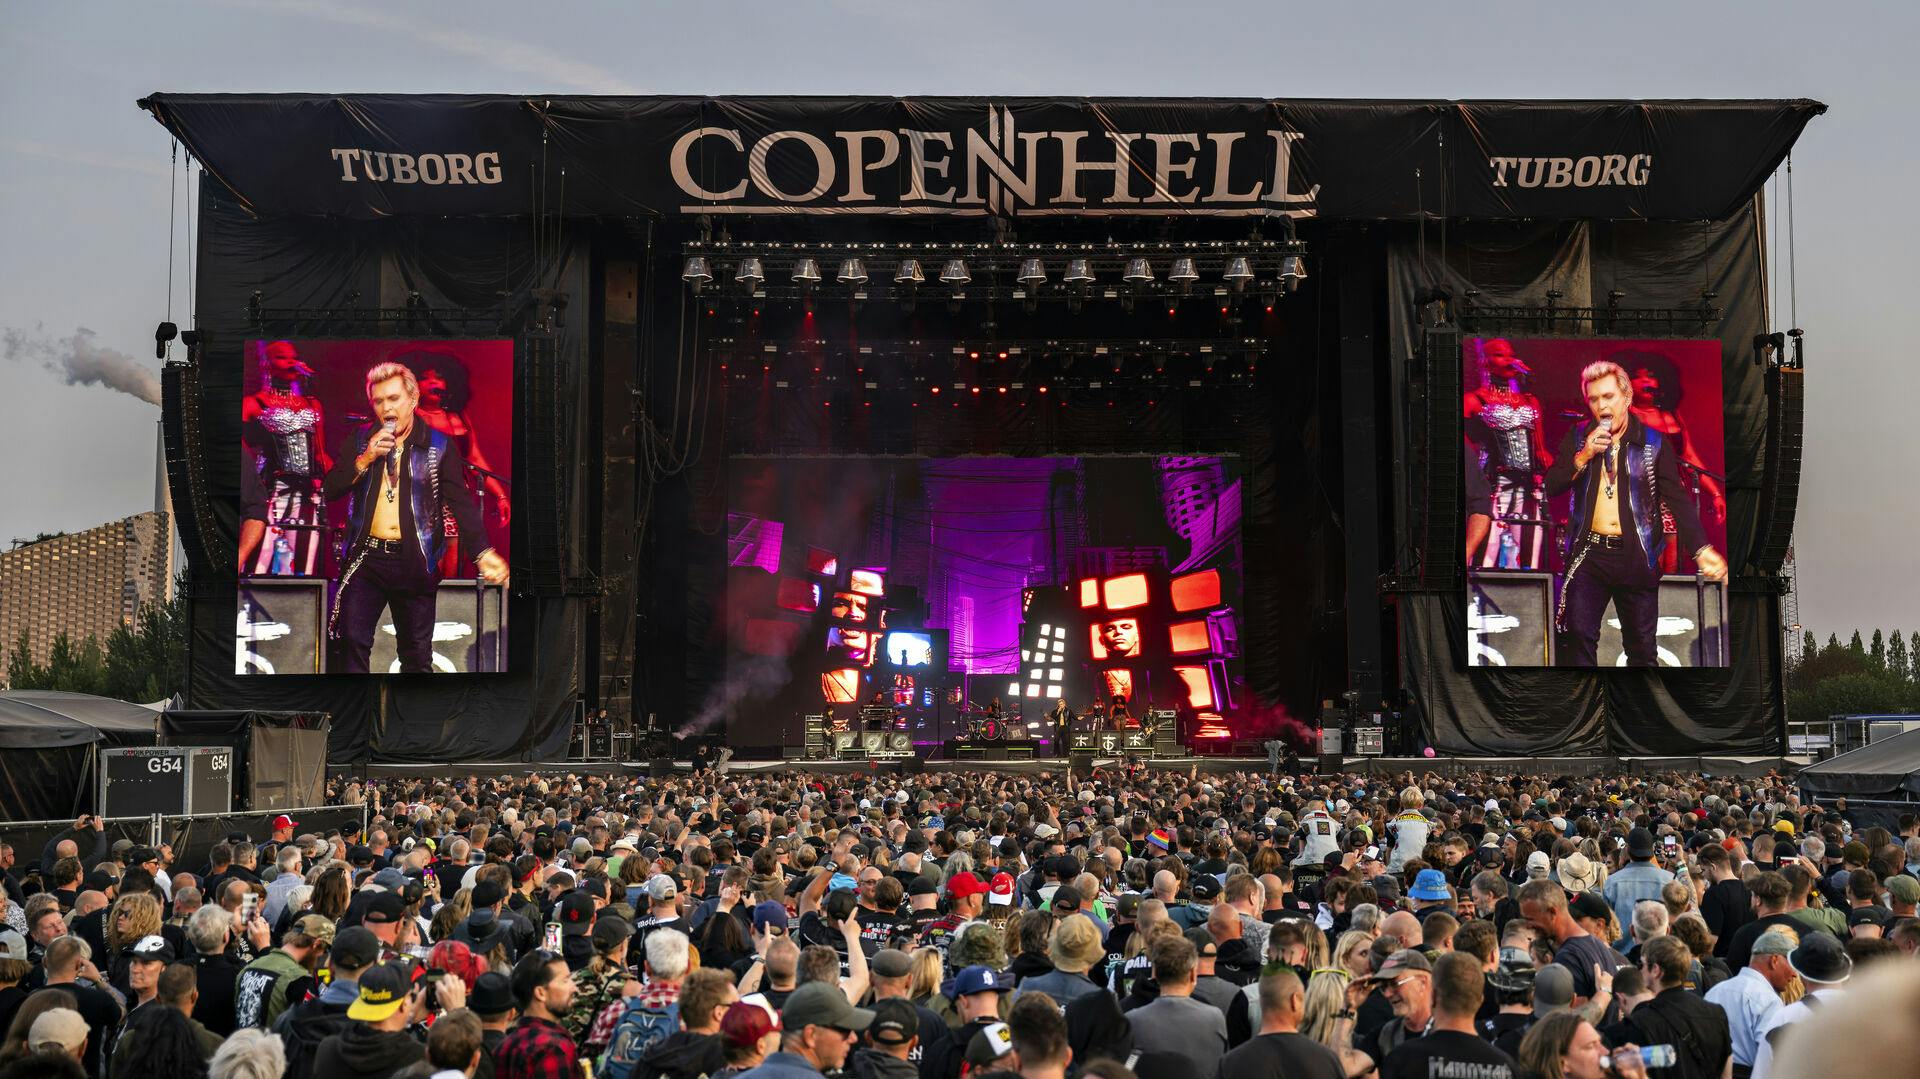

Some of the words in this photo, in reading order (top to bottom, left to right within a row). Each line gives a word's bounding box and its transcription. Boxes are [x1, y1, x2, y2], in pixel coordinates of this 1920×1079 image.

[331, 148, 503, 185] TUBORG
[669, 102, 1321, 217] COPENHELL
[1489, 153, 1652, 188] TUBORG
[147, 757, 183, 773] G54
[211, 755, 228, 771] G54
